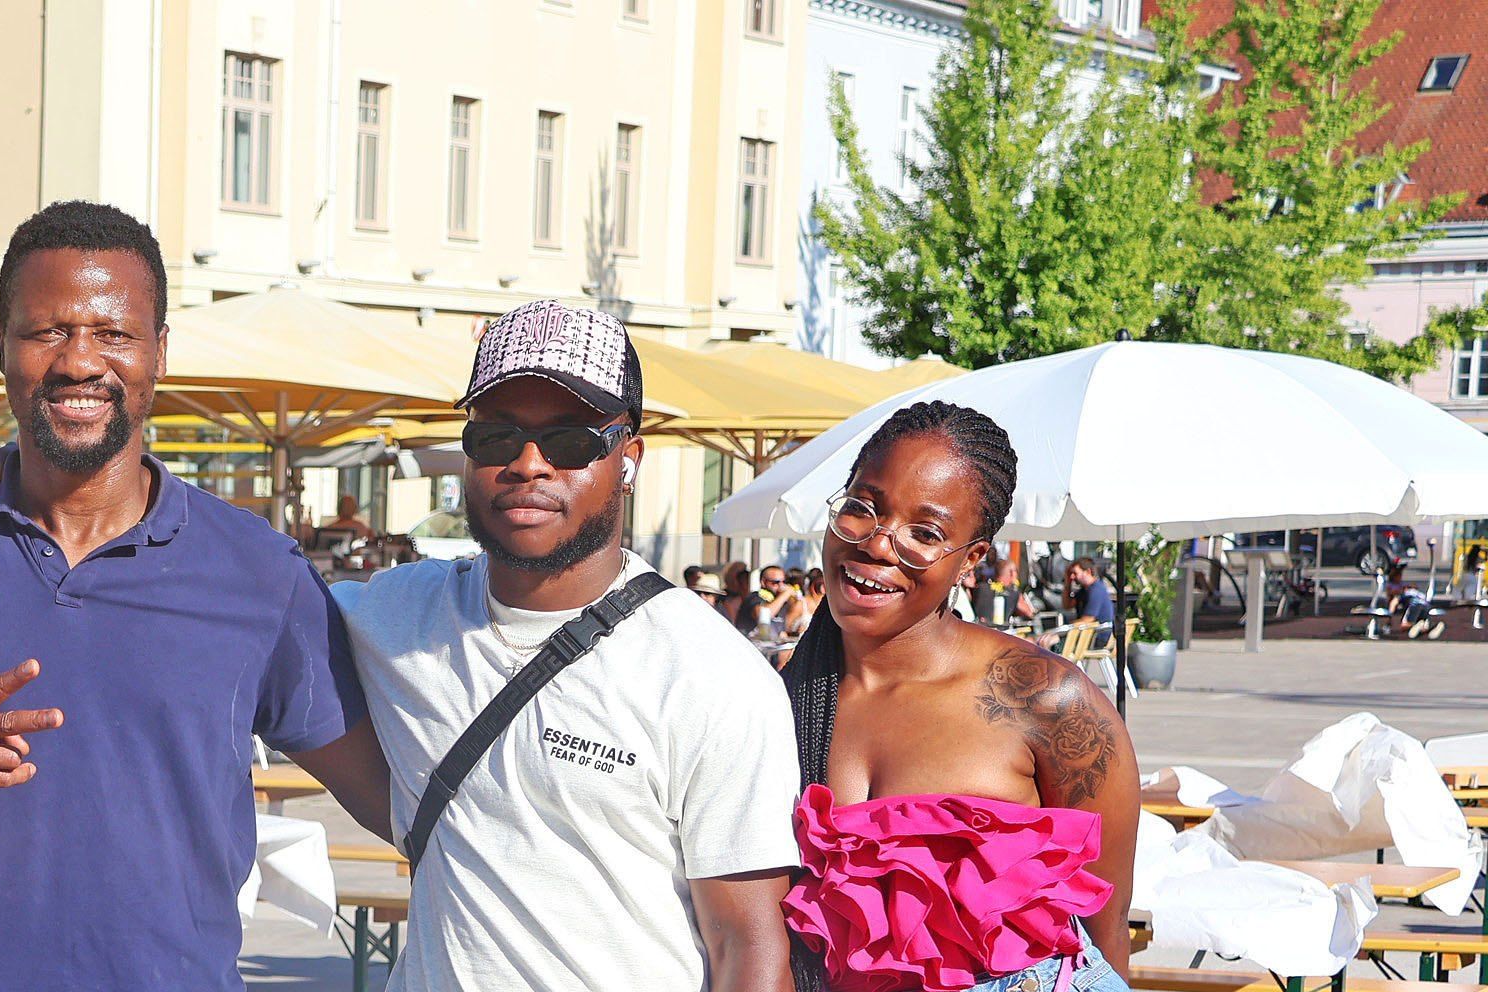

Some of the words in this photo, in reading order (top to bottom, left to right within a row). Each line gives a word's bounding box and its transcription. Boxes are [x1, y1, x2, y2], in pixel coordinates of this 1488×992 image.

[543, 728, 637, 766] ESSENTIALS
[550, 747, 576, 762] FEAR
[578, 755, 592, 767] OF
[594, 760, 615, 774] GOD
